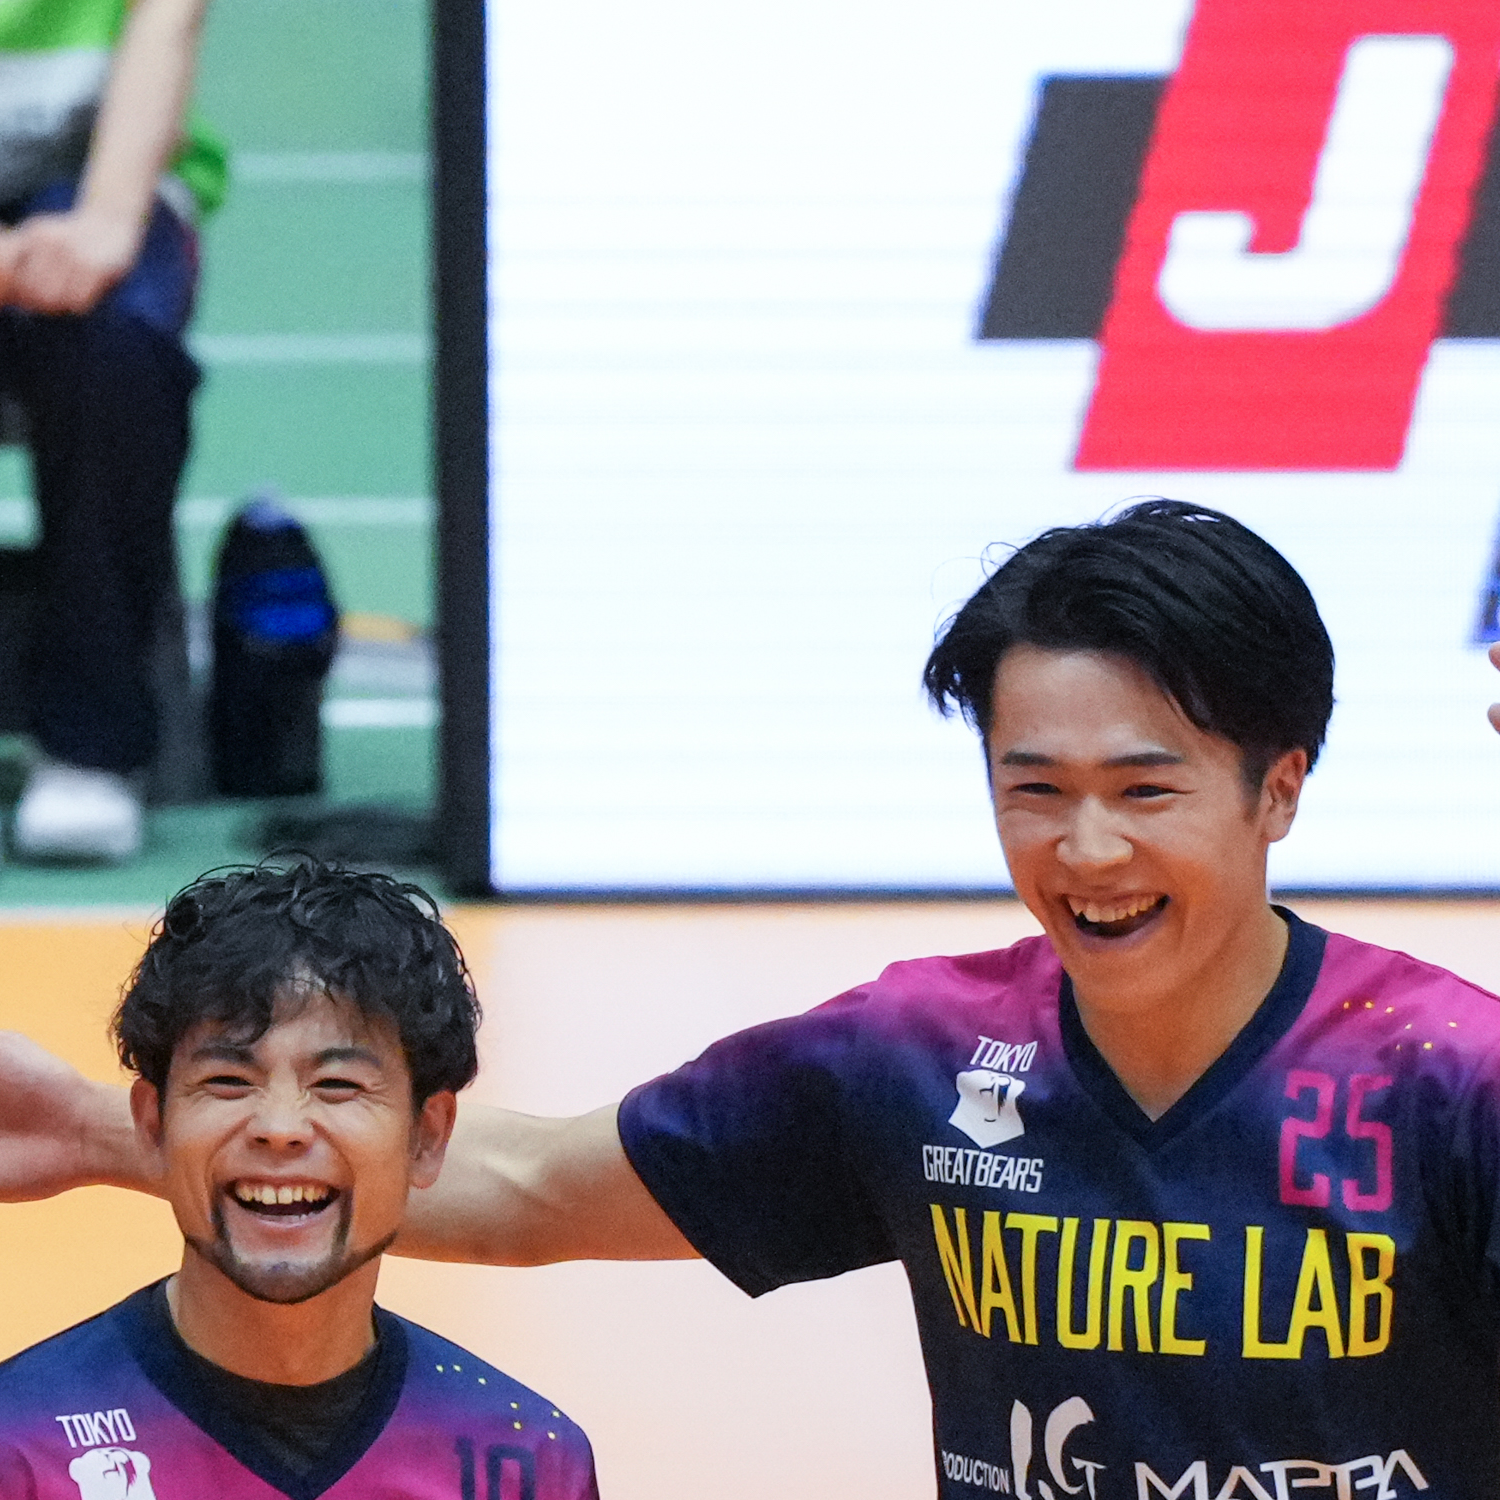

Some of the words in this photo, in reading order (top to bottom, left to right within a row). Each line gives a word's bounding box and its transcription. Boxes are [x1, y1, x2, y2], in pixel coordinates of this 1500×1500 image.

[1156, 32, 1455, 333] J
[969, 1035, 1038, 1073] TOKYO
[922, 1144, 1044, 1193] GREATBEARS
[1279, 1069, 1395, 1212] 25
[930, 1204, 1210, 1356] NATURE
[1242, 1226, 1397, 1360] LAB
[55, 1408, 136, 1448] TOKYO
